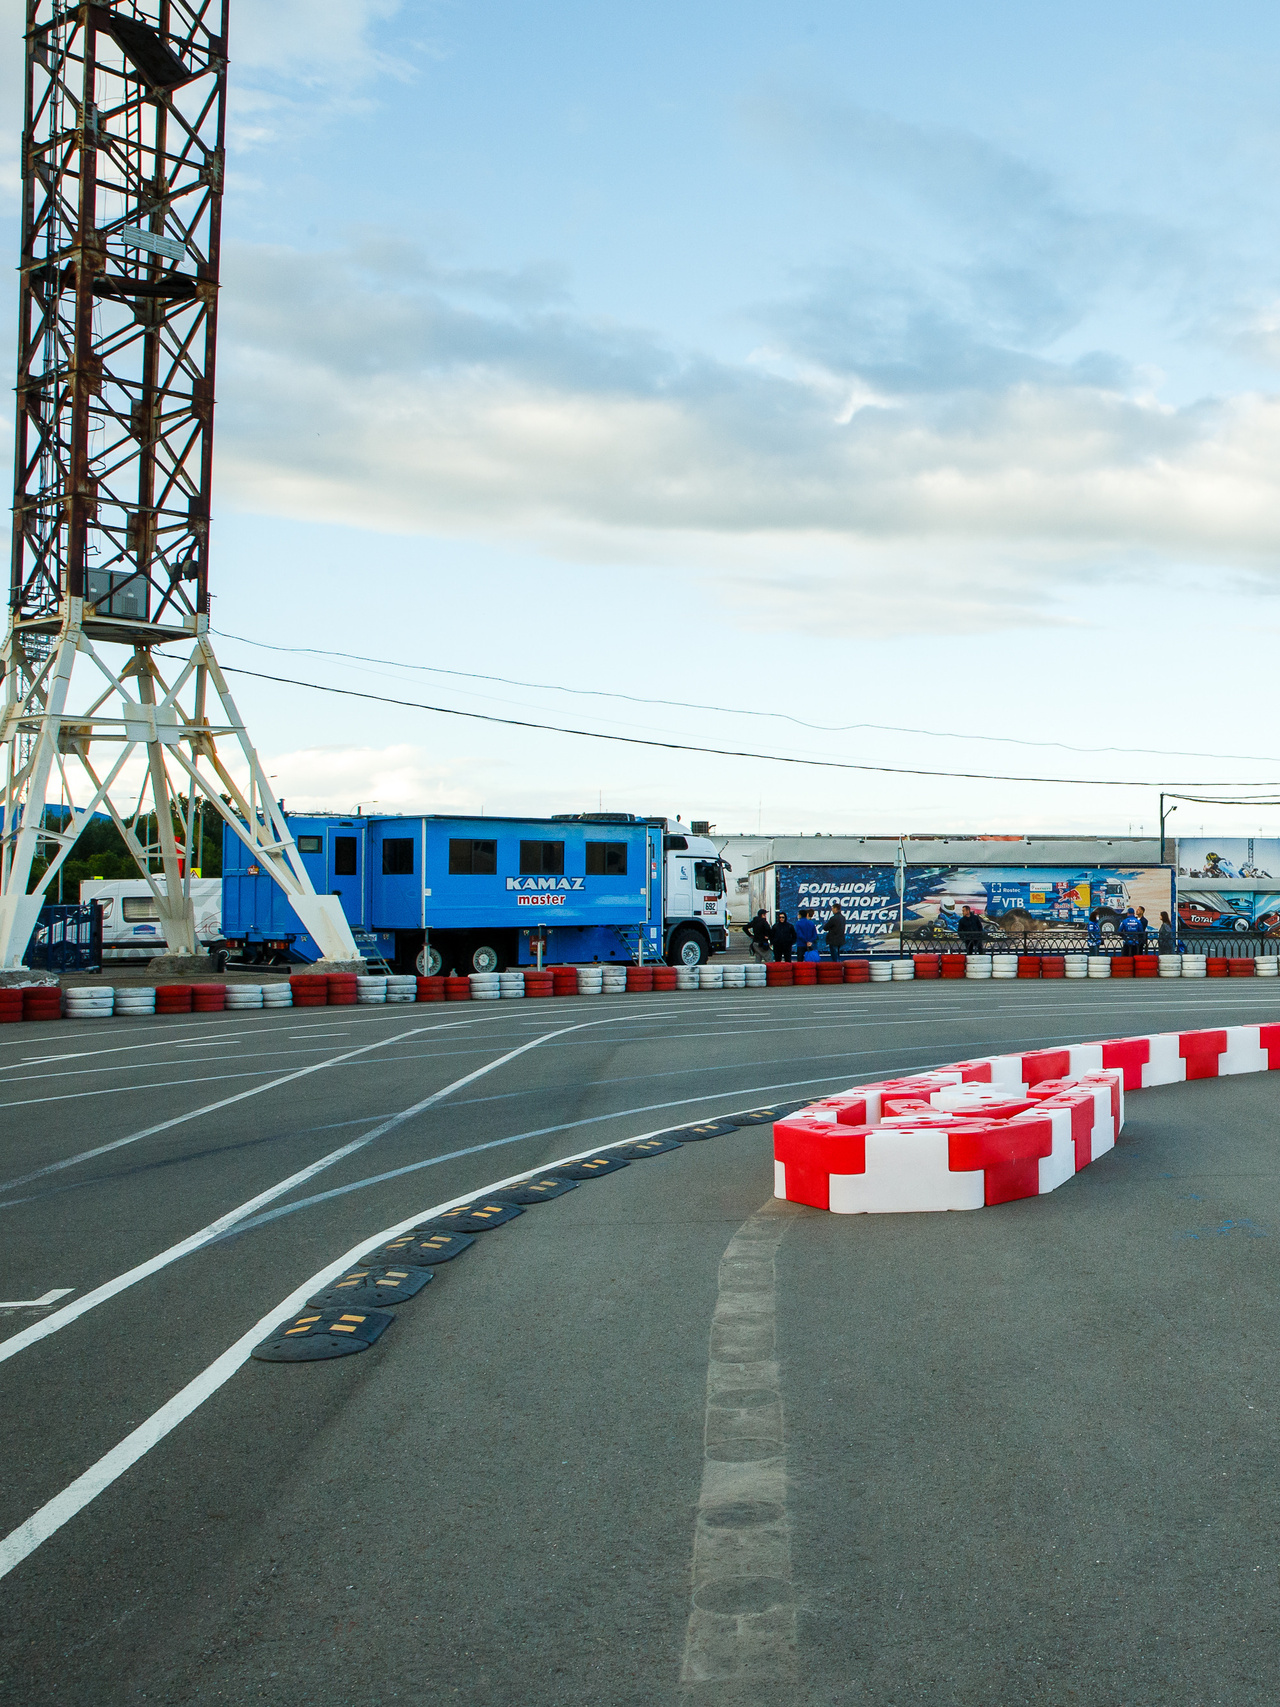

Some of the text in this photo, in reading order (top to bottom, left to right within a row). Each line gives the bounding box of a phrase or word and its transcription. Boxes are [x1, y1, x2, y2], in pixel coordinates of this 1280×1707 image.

[506, 877, 586, 890] KAMAZ
[798, 880, 876, 894] БОЛЬШОЙ
[518, 893, 566, 906] master
[798, 896, 890, 907] АВТОСПОРТ
[1002, 897, 1024, 908] VTB
[705, 902, 716, 911] 692
